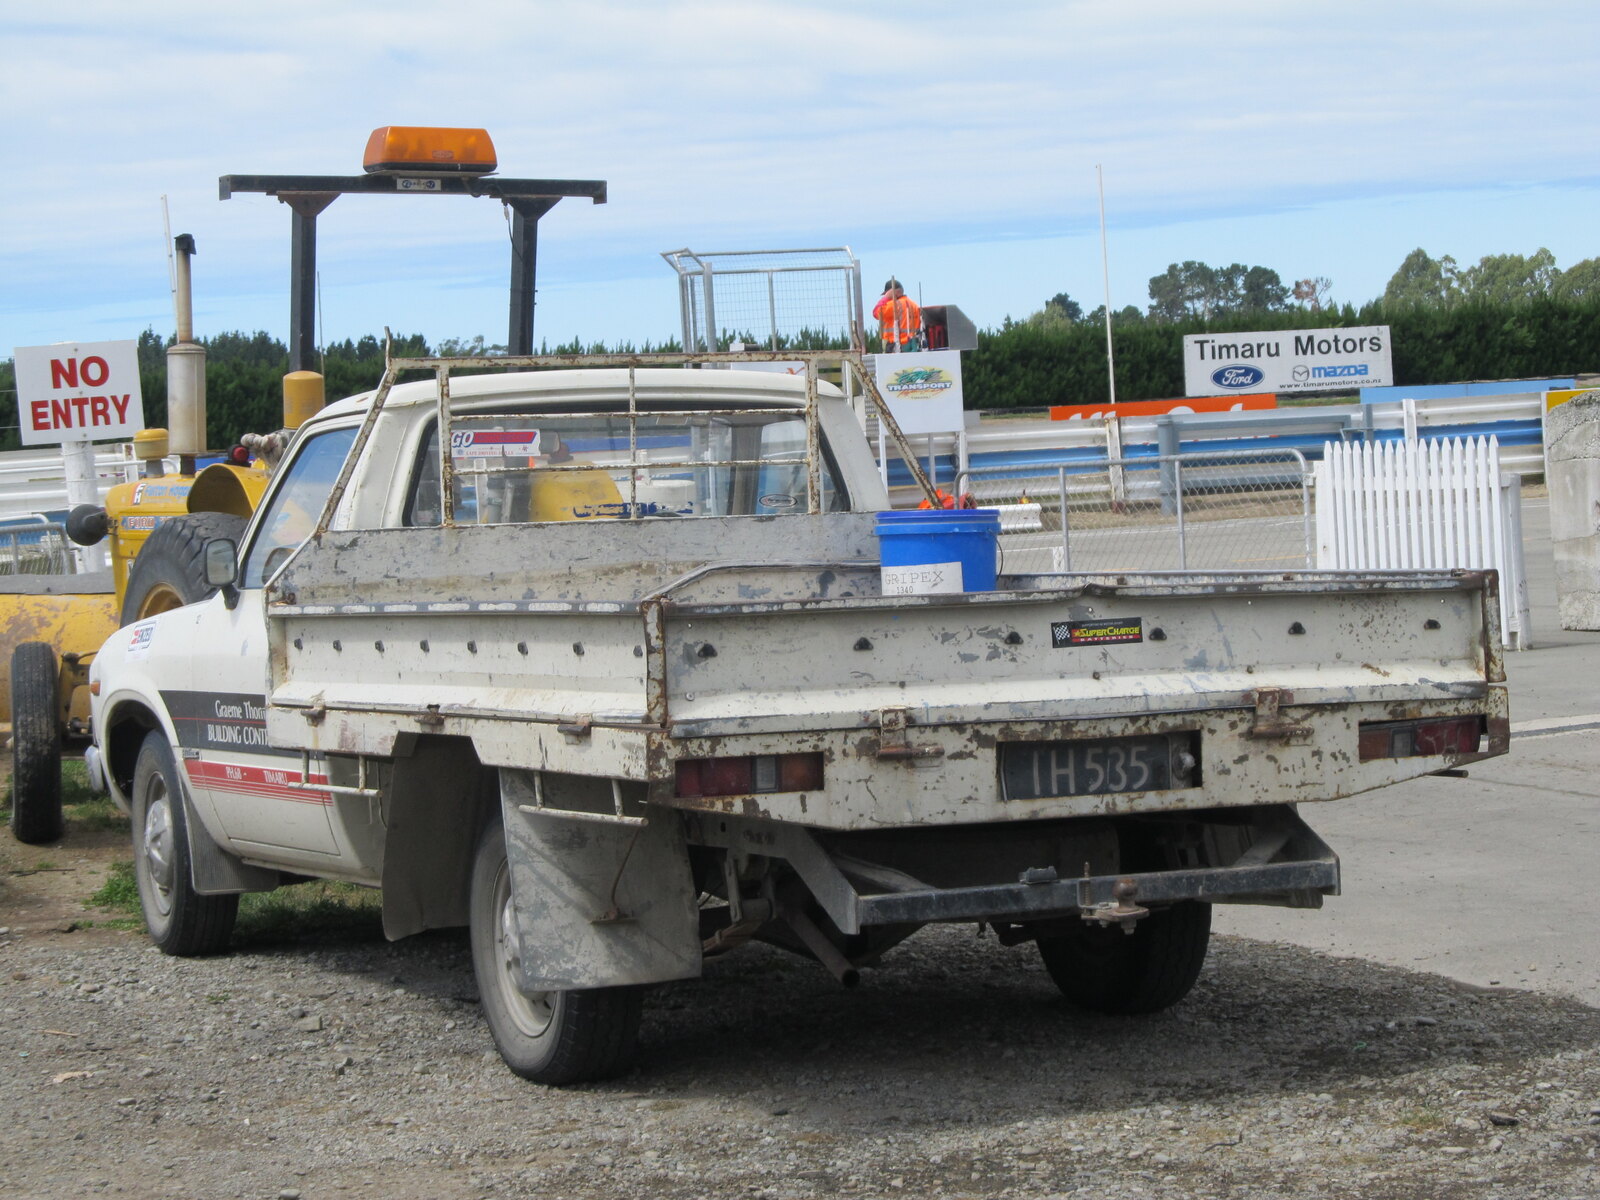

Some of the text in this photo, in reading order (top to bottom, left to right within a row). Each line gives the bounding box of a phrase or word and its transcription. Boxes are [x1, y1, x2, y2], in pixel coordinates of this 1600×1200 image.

[1194, 335, 1383, 361] Timaru Motors
[50, 356, 110, 389] NO
[1222, 368, 1254, 385] Ford
[1311, 364, 1369, 378] mazda
[887, 382, 952, 392] TRANSPORT
[1279, 378, 1382, 389] www.timarumotors.co.nz
[31, 394, 131, 431] ENTRY
[451, 430, 475, 448] GO
[885, 571, 944, 585] GRIPEX
[896, 586, 914, 594] 1340
[215, 700, 243, 719] Graeme
[208, 724, 242, 744] BUILDING
[263, 770, 288, 785] TIMARU
